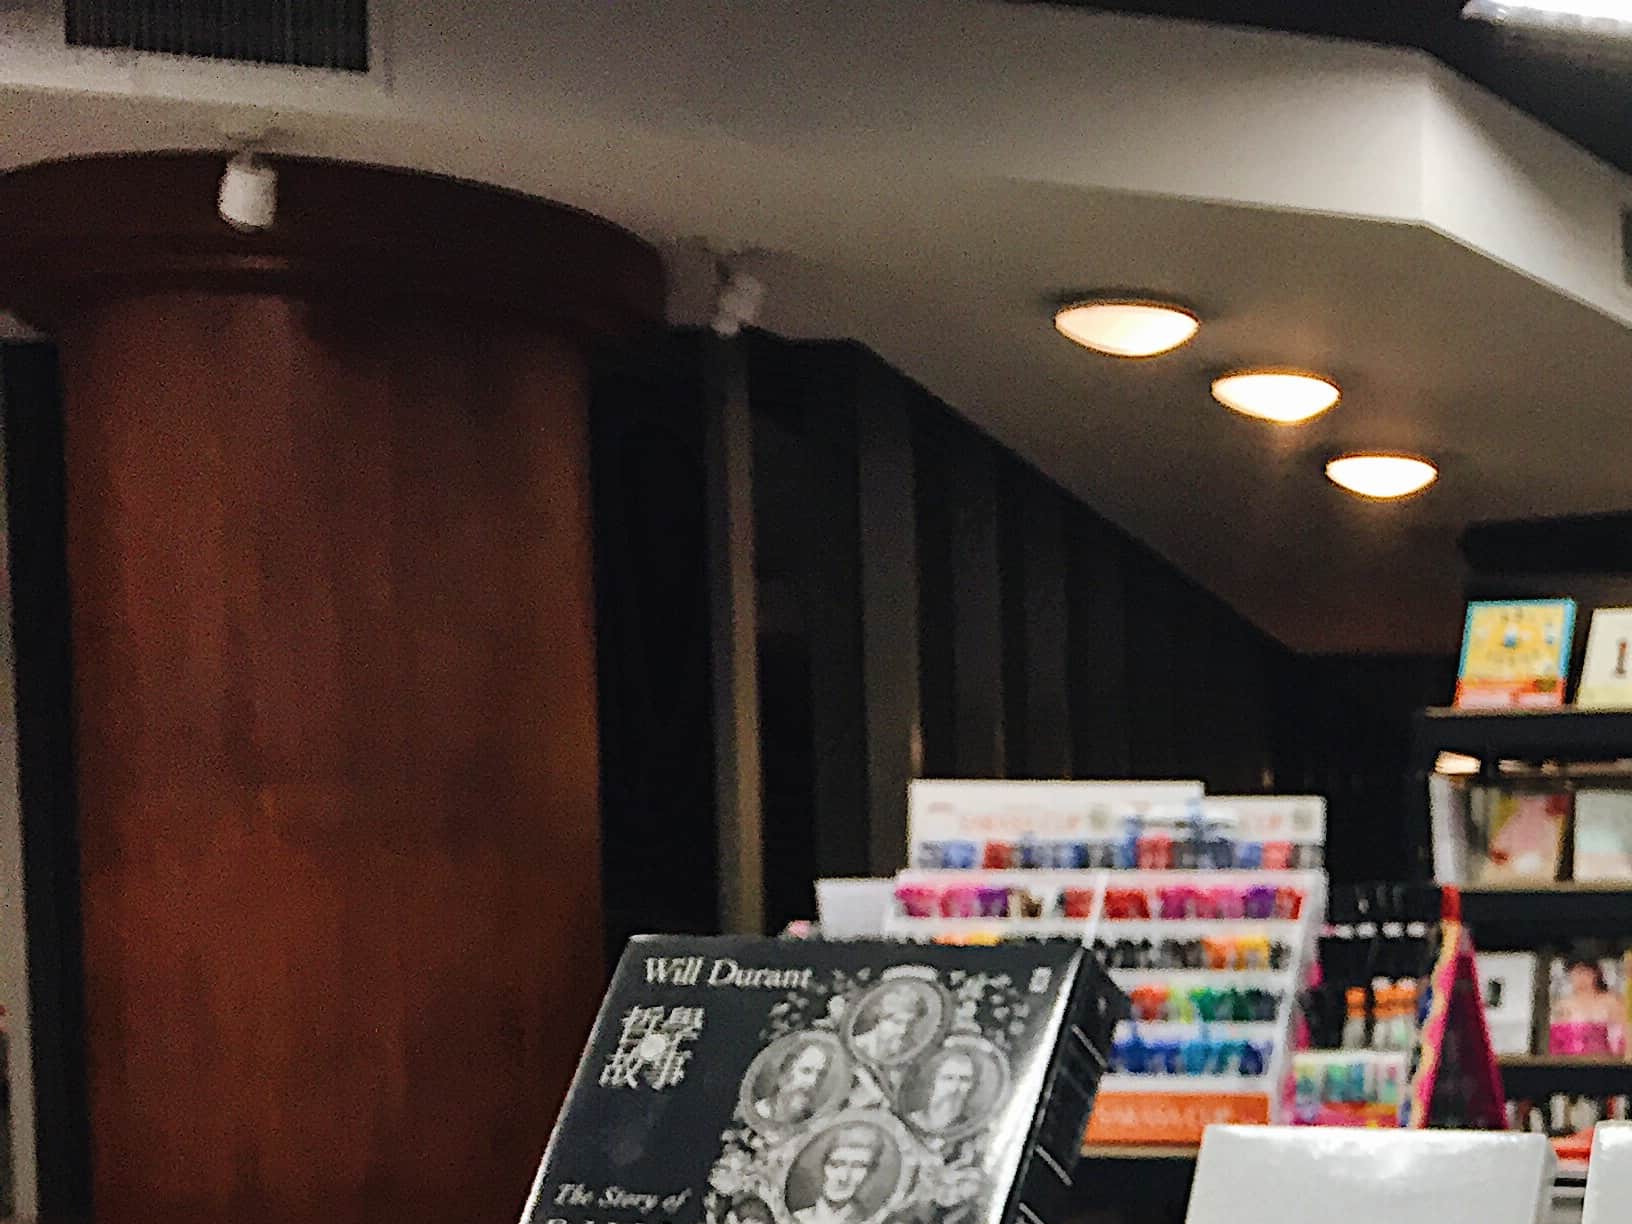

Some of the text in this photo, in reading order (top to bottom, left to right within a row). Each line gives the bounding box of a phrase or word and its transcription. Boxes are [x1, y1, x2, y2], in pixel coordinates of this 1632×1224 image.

[645, 956, 812, 989] Will Durant
[553, 1183, 693, 1215] The Story of
